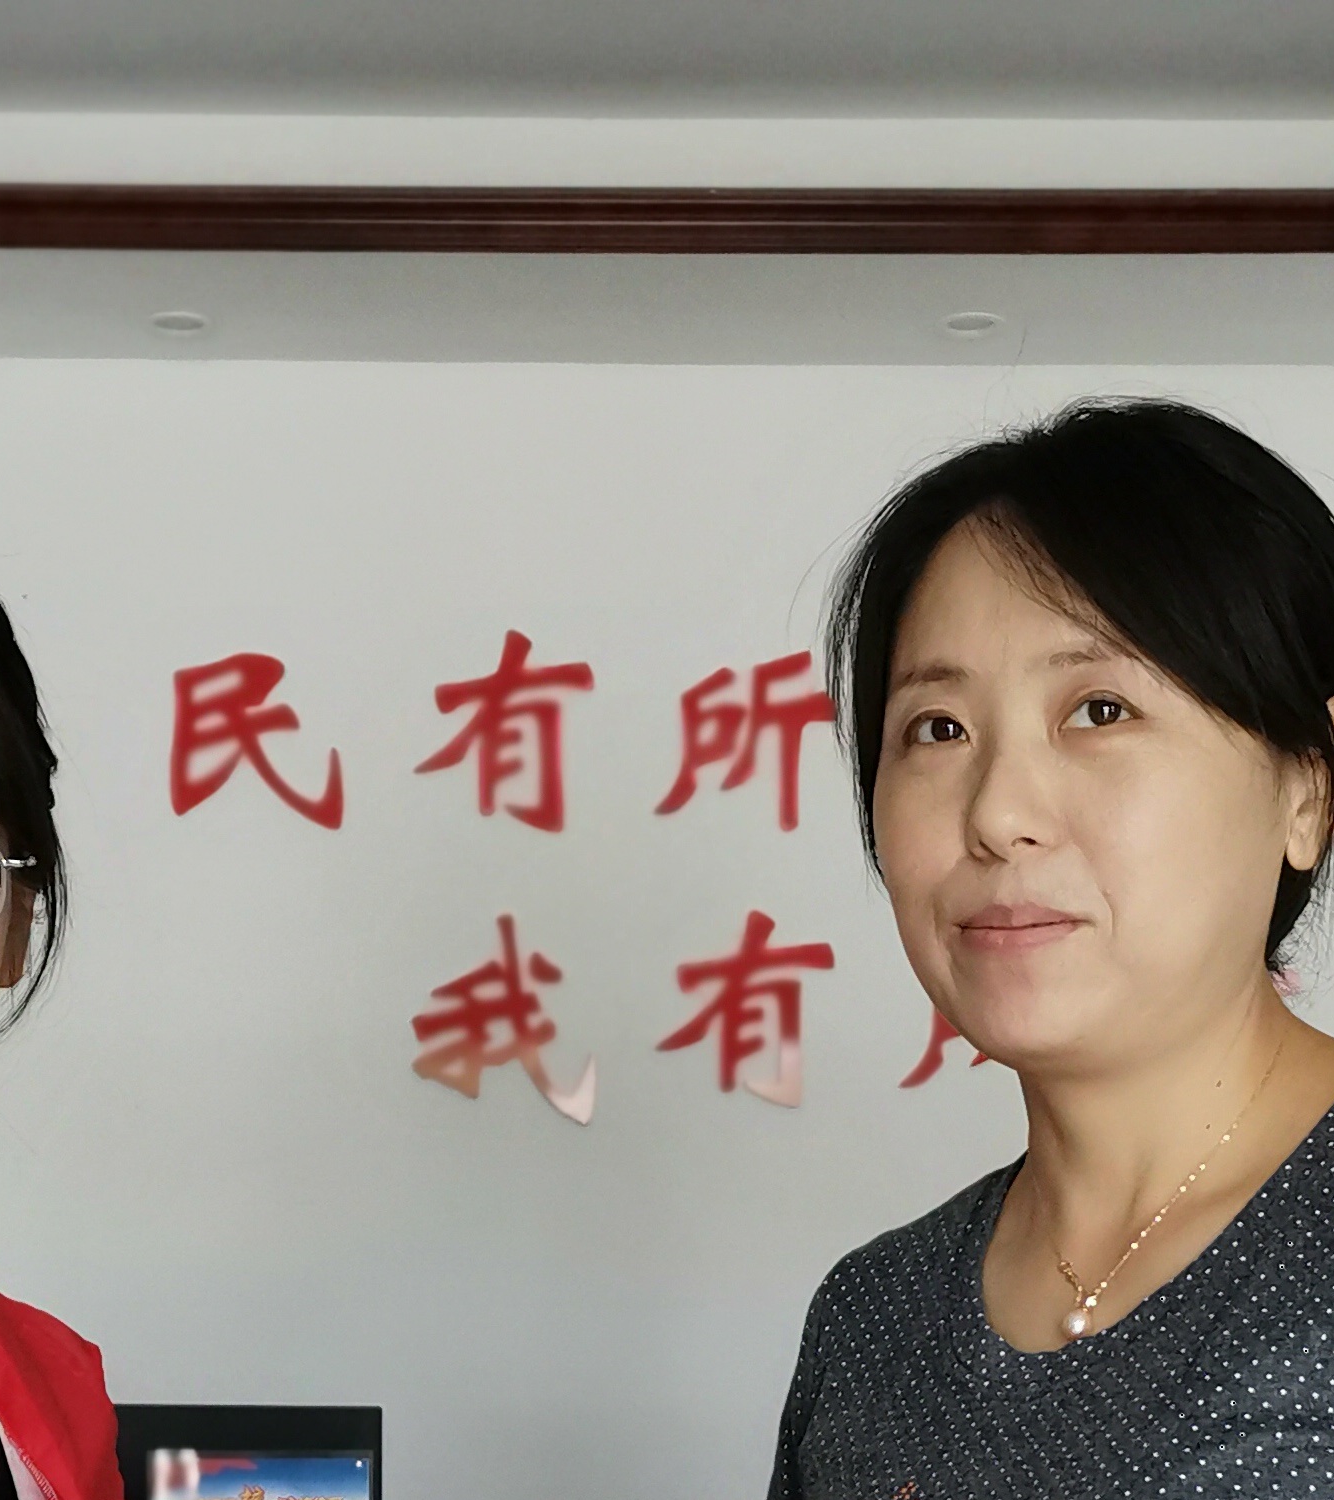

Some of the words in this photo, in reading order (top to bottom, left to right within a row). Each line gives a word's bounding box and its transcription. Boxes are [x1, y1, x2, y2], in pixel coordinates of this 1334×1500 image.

[169, 630, 835, 832] 民有所
[412, 912, 992, 1126] 我有
